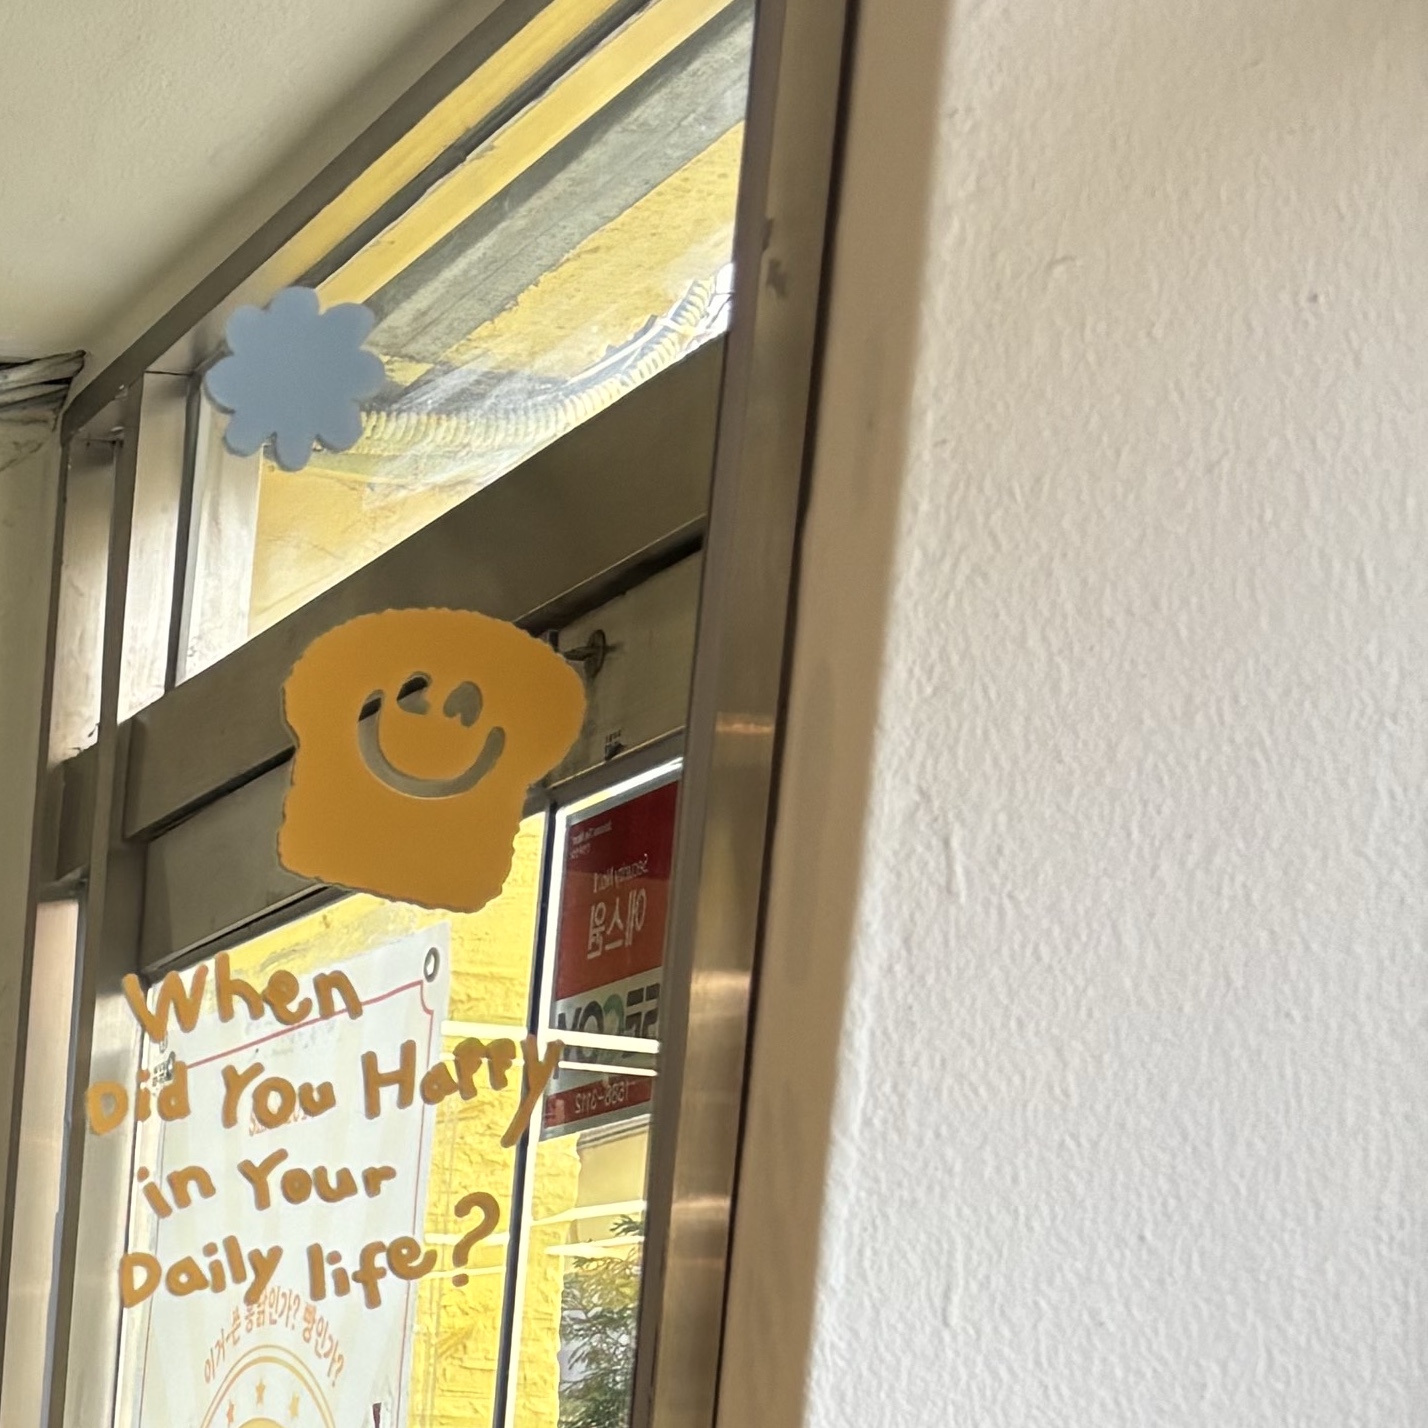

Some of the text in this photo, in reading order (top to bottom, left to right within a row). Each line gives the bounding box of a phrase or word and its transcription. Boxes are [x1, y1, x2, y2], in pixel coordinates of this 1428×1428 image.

[122, 952, 363, 1042] When
[87, 1060, 191, 1135] Did
[136, 1148, 397, 1219] in Your
[118, 1235, 284, 1309] Daily
[301, 1303, 345, 1388] 빵인가?
